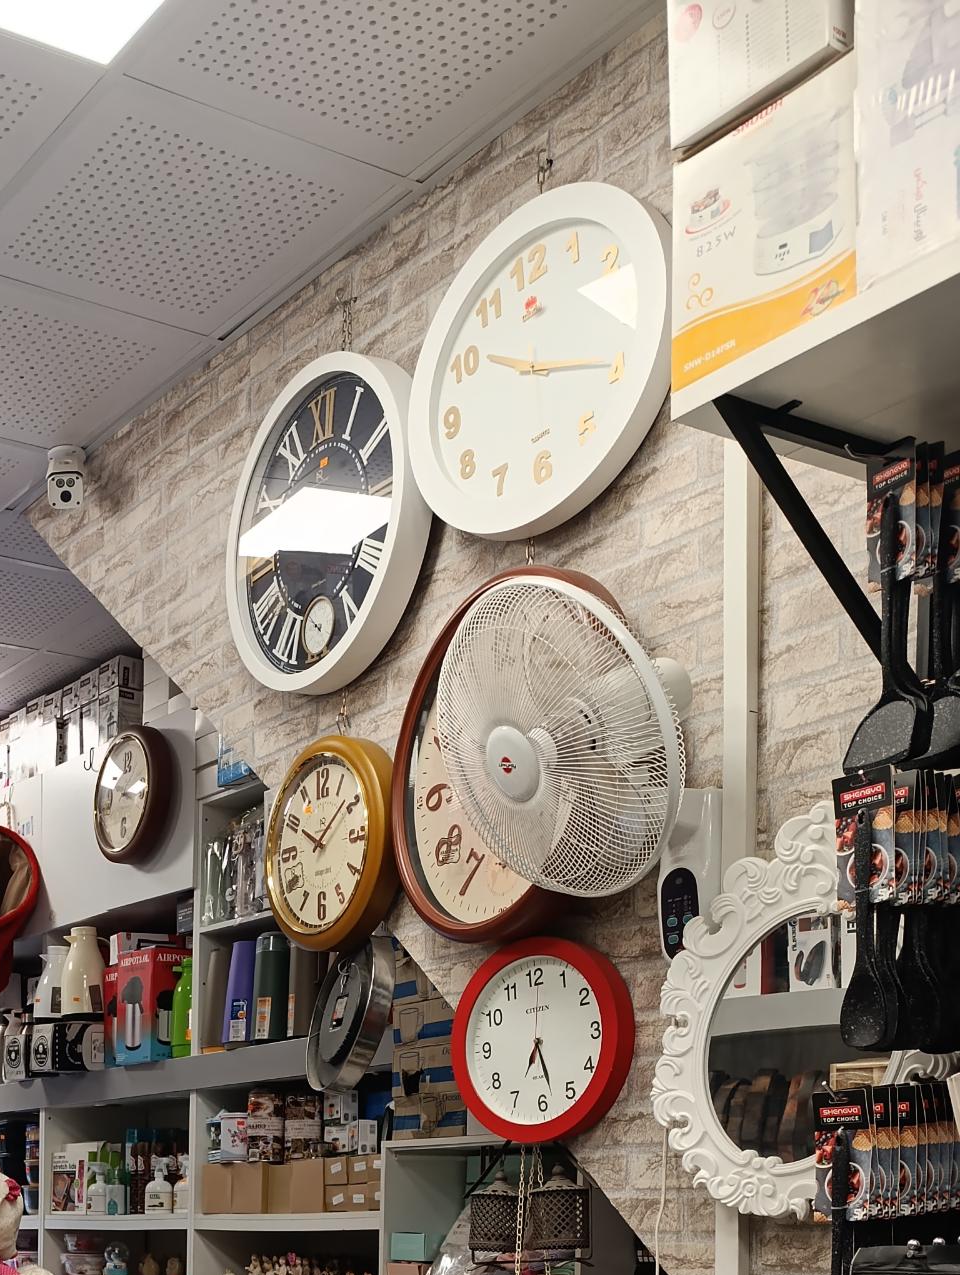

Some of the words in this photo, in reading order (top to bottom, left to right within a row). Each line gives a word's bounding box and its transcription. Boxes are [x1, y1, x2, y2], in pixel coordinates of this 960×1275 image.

[565, 231, 581, 263] 1
[509, 243, 550, 291] 12
[599, 246, 620, 275] 2
[475, 287, 504, 328] 11
[450, 345, 480, 384] 10
[607, 351, 626, 385] 4
[443, 405, 462, 440] 9
[578, 410, 597, 445] 5
[458, 448, 477, 480] 8
[532, 449, 553, 485] 6
[491, 462, 510, 496] 7
[875, 479, 887, 490] TOP
[888, 470, 908, 485] CHOICE
[316, 767, 331, 797] 12
[345, 793, 361, 814] 2
[843, 801, 855, 810] TOP
[858, 794, 883, 806] CHOICE
[284, 812, 301, 834] 10
[281, 845, 298, 864] 9
[346, 860, 362, 879] 4
[458, 850, 486, 897] 7
[316, 891, 327, 921] 6
[525, 966, 544, 987] 12
[560, 970, 569, 988] 1
[503, 983, 519, 1002] 11
[578, 987, 590, 1006] 2
[486, 1008, 503, 1027] 10
[525, 1004, 550, 1015] CITIZEN
[590, 1020, 602, 1040] 3
[481, 1042, 492, 1059] 9
[583, 1055, 594, 1075] 4
[491, 1072, 502, 1090] 8
[564, 1080, 576, 1100] 5
[510, 1090, 520, 1109] 7
[537, 1093, 549, 1112] 6
